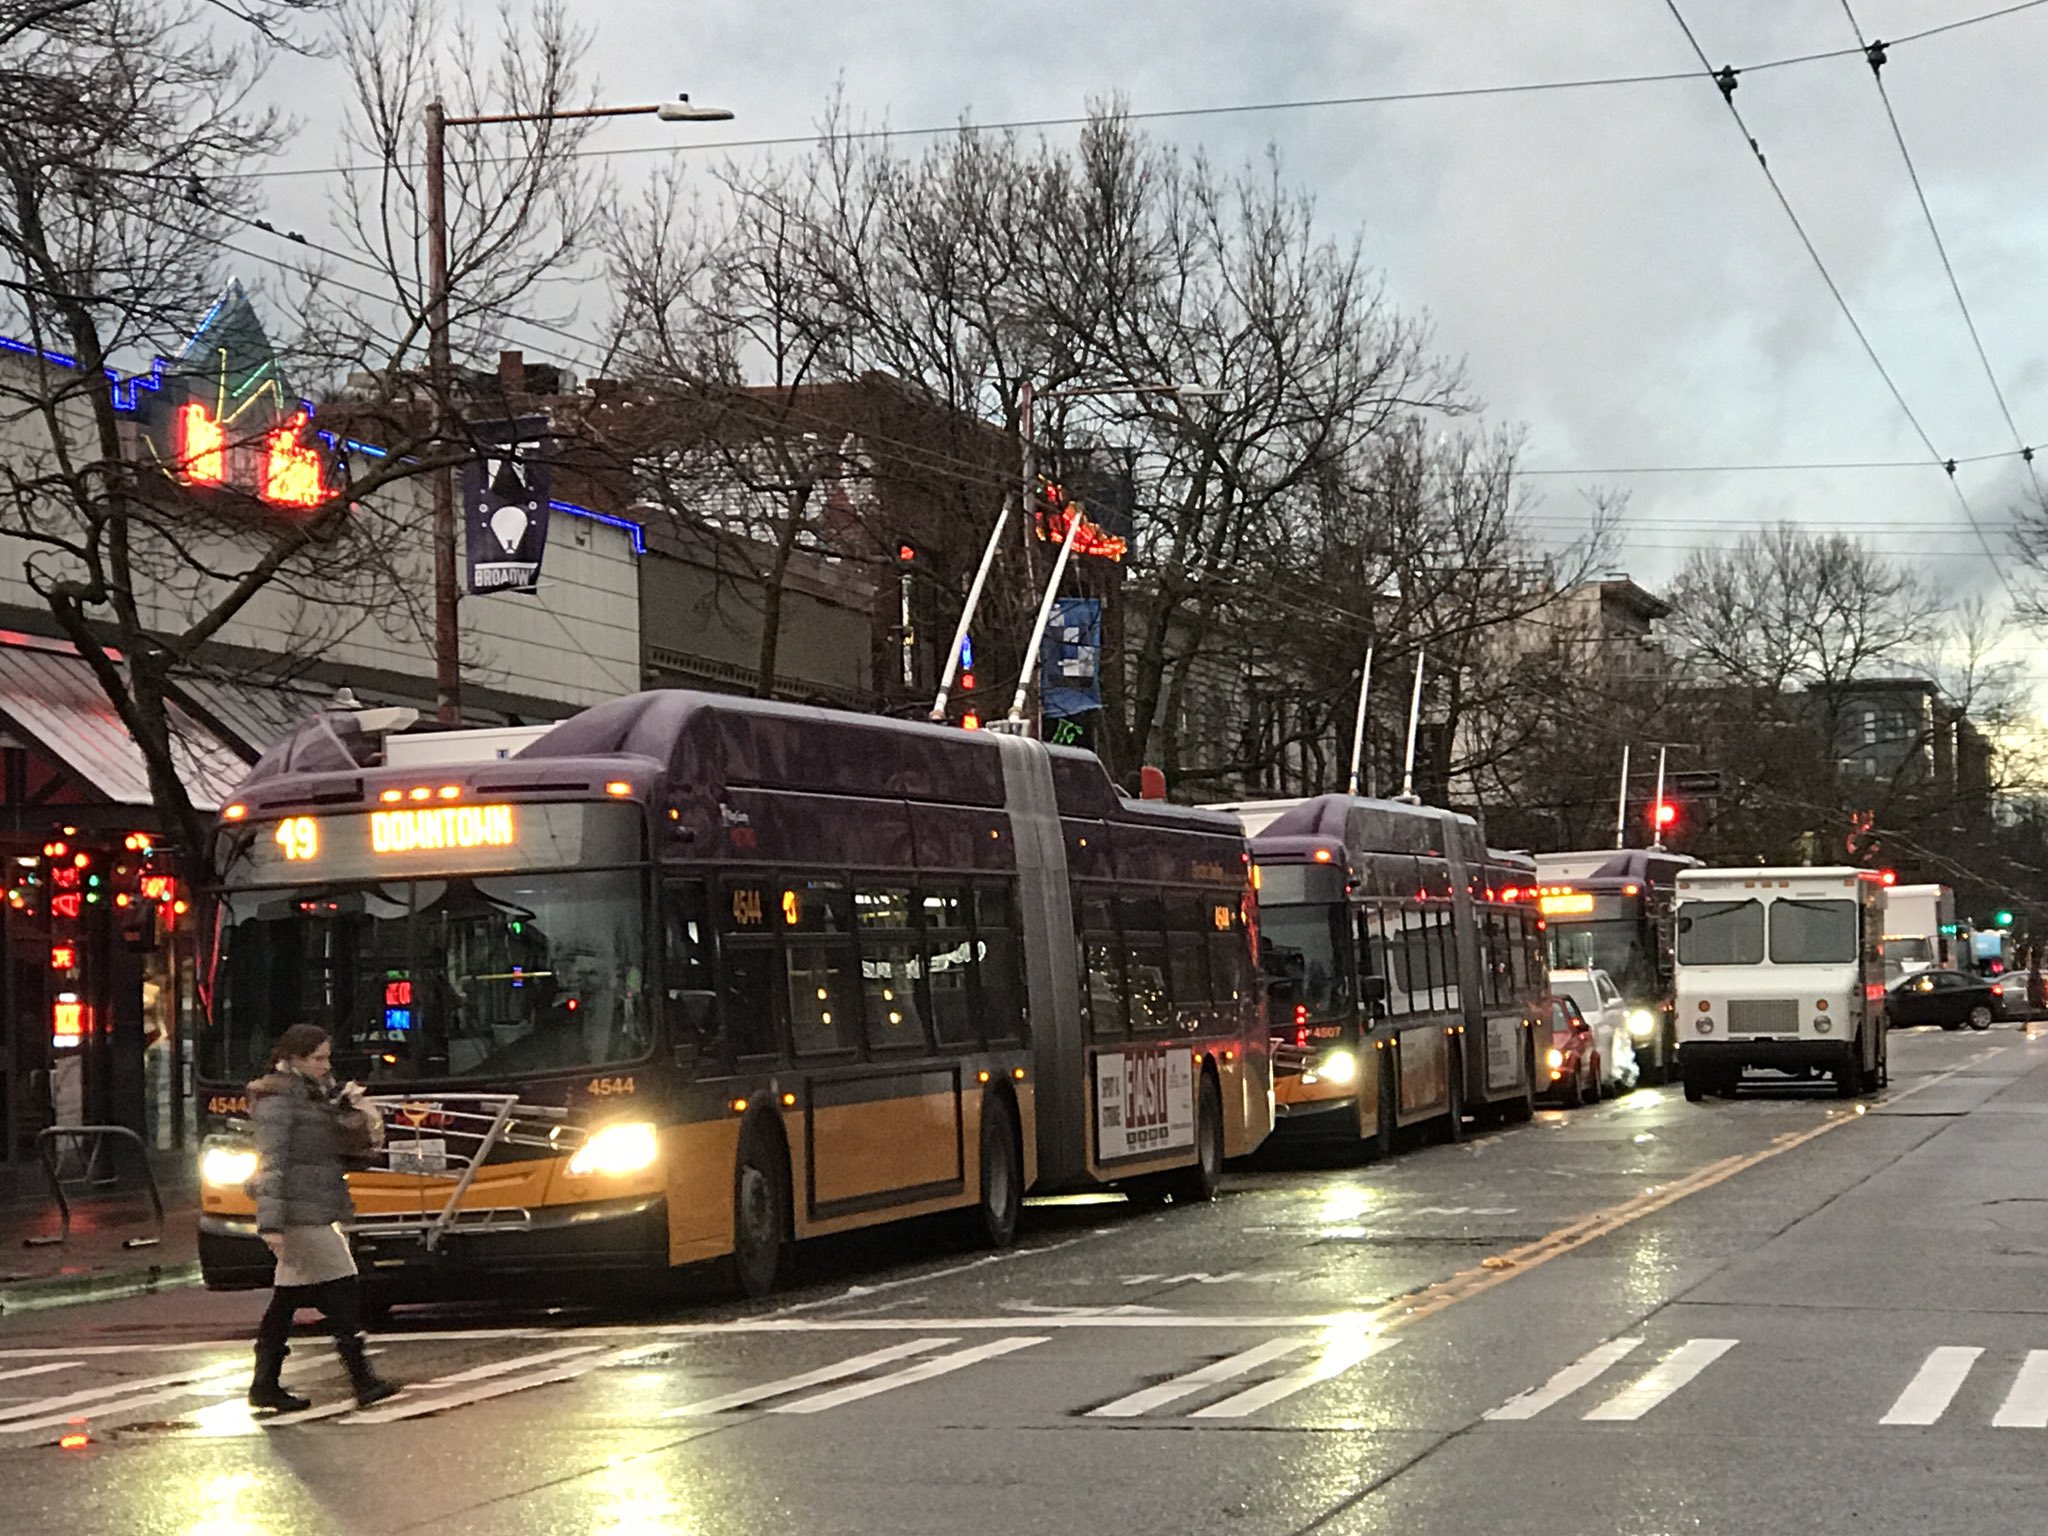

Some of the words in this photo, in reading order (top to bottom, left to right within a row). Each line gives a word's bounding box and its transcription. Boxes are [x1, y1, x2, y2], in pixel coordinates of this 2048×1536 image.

[475, 569, 536, 587] BROADW
[275, 817, 319, 860] 49
[370, 804, 514, 853] DOWNTOWN
[732, 889, 763, 924] 4544
[587, 1077, 635, 1096] 4544
[1124, 1054, 1168, 1125] FAST
[208, 1096, 247, 1115] 4544
